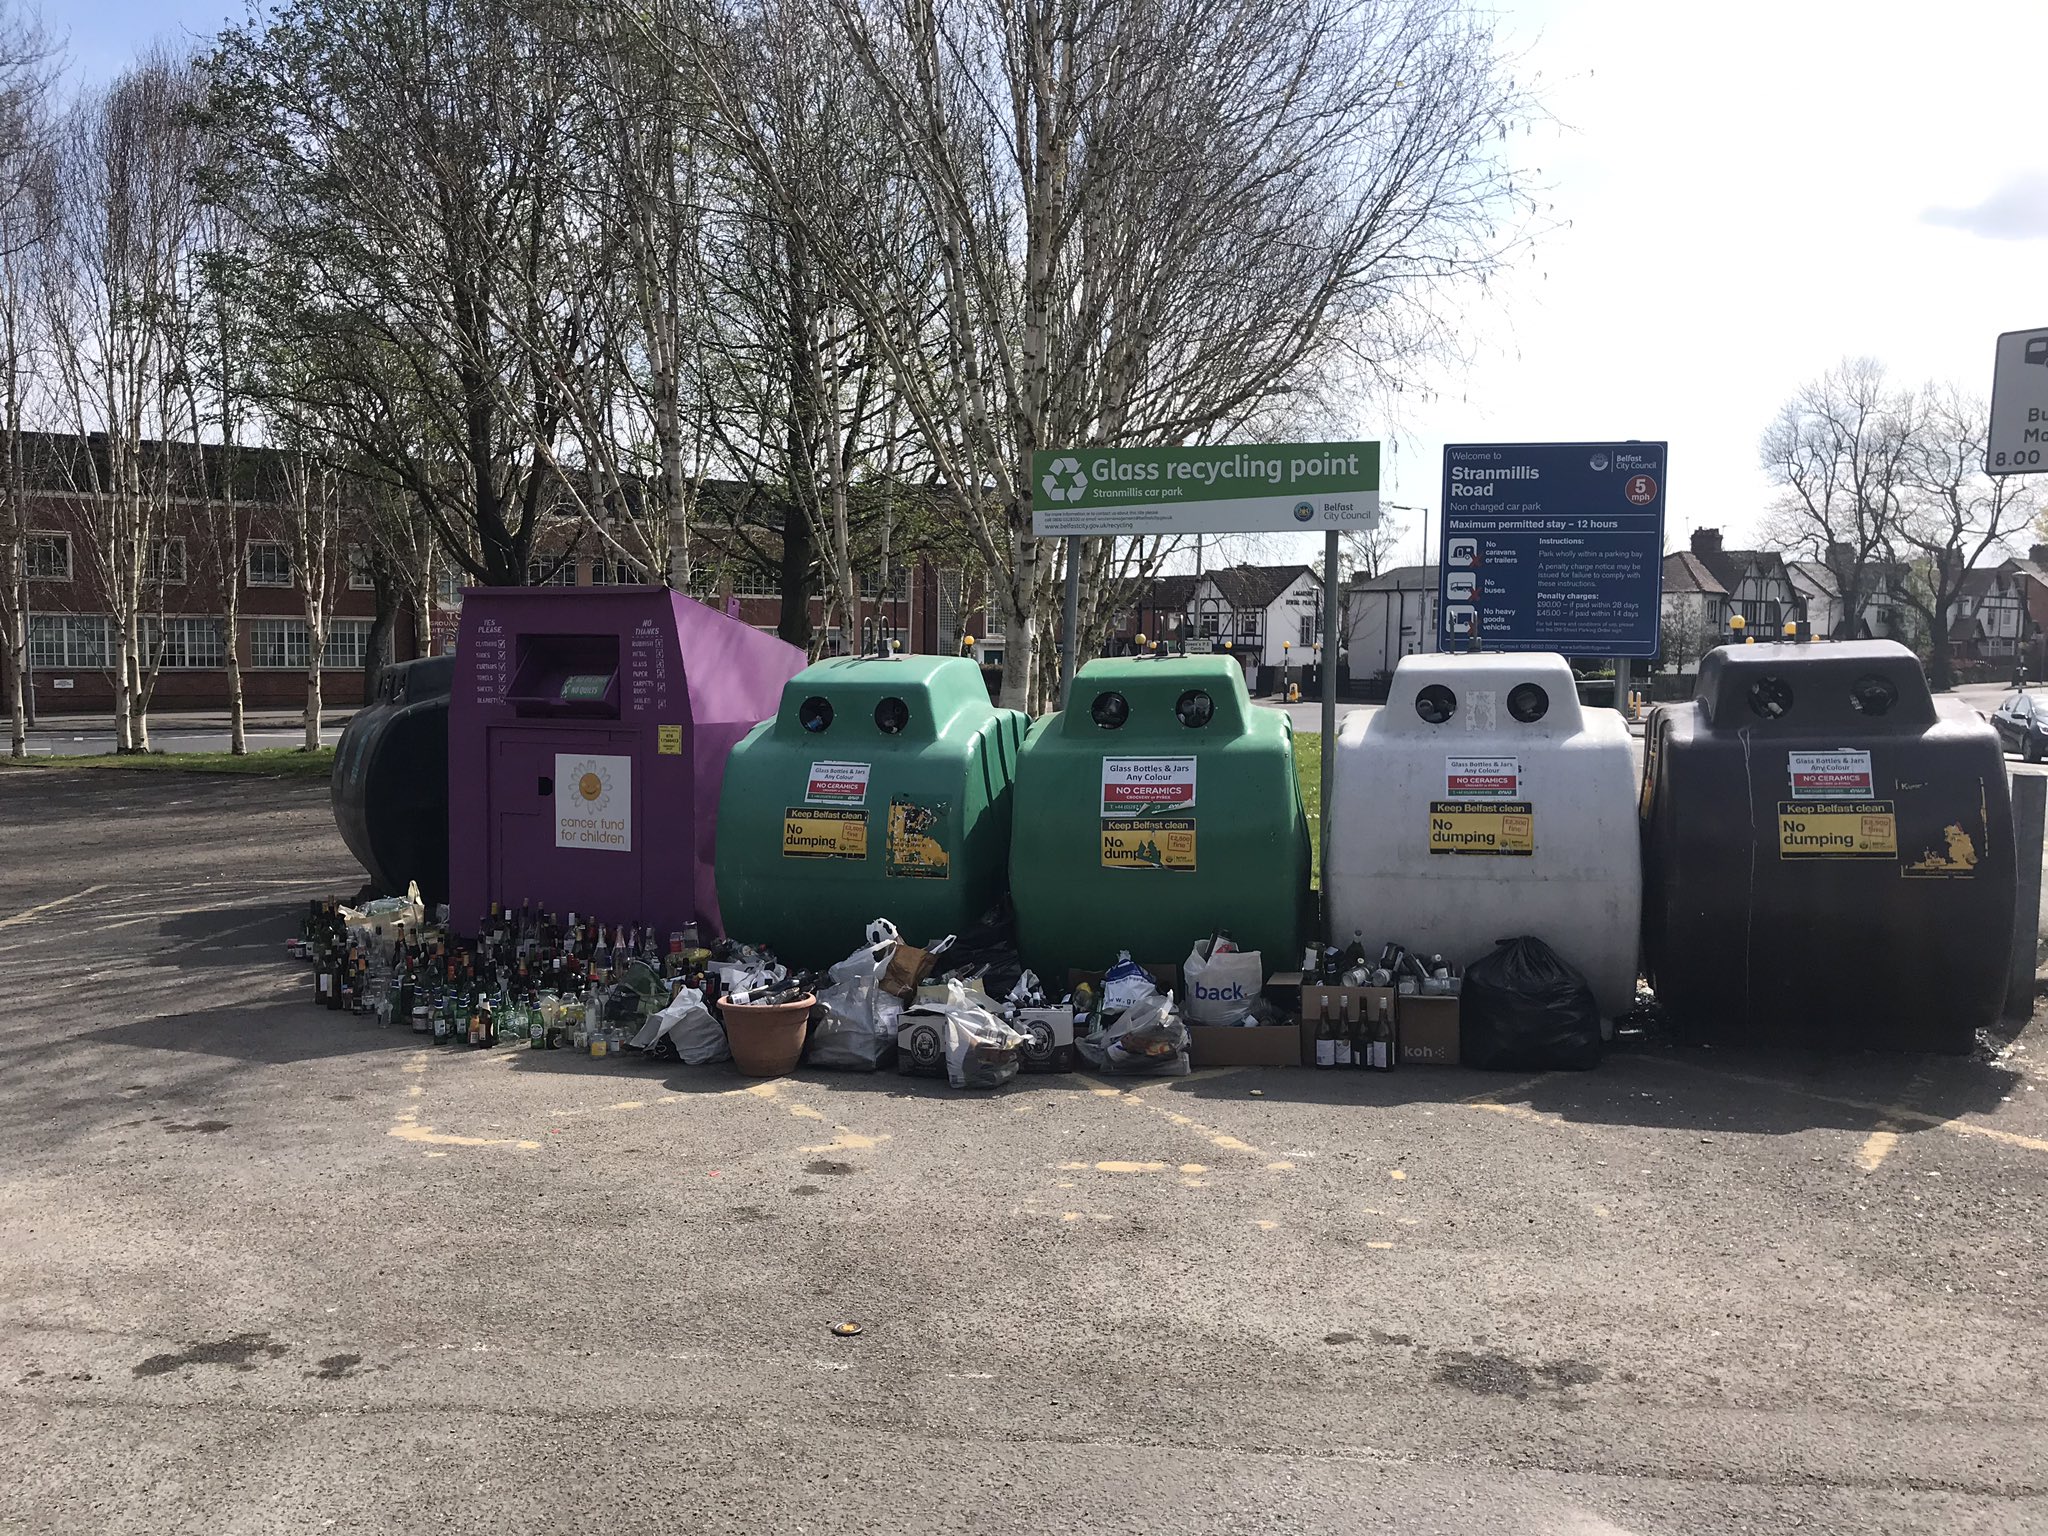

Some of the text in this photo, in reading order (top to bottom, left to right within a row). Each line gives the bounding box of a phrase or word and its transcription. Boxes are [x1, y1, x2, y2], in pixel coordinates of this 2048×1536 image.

[1452, 452, 1491, 460] Welcome
[1995, 450, 2040, 467] 8.00
[1092, 452, 1358, 486] Glass recycling point
[1616, 462, 1630, 472] City
[1452, 466, 1540, 480] Stranmillis
[1452, 483, 1494, 496] Road
[1634, 478, 1646, 494] 5
[1093, 486, 1182, 498] Stranmillis car park
[1632, 493, 1650, 502] mph
[1324, 502, 1354, 512] Belfast
[1450, 502, 1468, 511] Non
[1470, 502, 1504, 512] charged
[1522, 502, 1542, 512] park
[1323, 511, 1370, 522] City Council
[1450, 520, 1618, 530] Maximum permitted stay 12 hours
[1555, 550, 1576, 558] wholly
[1604, 550, 1629, 558] parking
[1630, 550, 1642, 558] bay
[1545, 562, 1569, 571] penalty
[1570, 562, 1594, 571] charge
[1601, 572, 1625, 580] comply
[1495, 608, 1515, 616] heavy
[1437, 803, 1462, 813] Keep
[1464, 804, 1497, 812] Belfast
[1787, 804, 1885, 814] Keep Belfast clean
[791, 810, 863, 820] Keep Belfast clean
[560, 818, 625, 830] cancer fund
[786, 824, 803, 835] No
[1108, 821, 1131, 830] Keep
[1432, 819, 1453, 830] No
[1783, 821, 1806, 832] No
[560, 830, 625, 844] for children
[786, 835, 836, 849] dumping
[1104, 836, 1124, 848] No
[1432, 831, 1495, 845] dumping
[1783, 833, 1854, 848] dumping
[1404, 1046, 1432, 1057] koh
